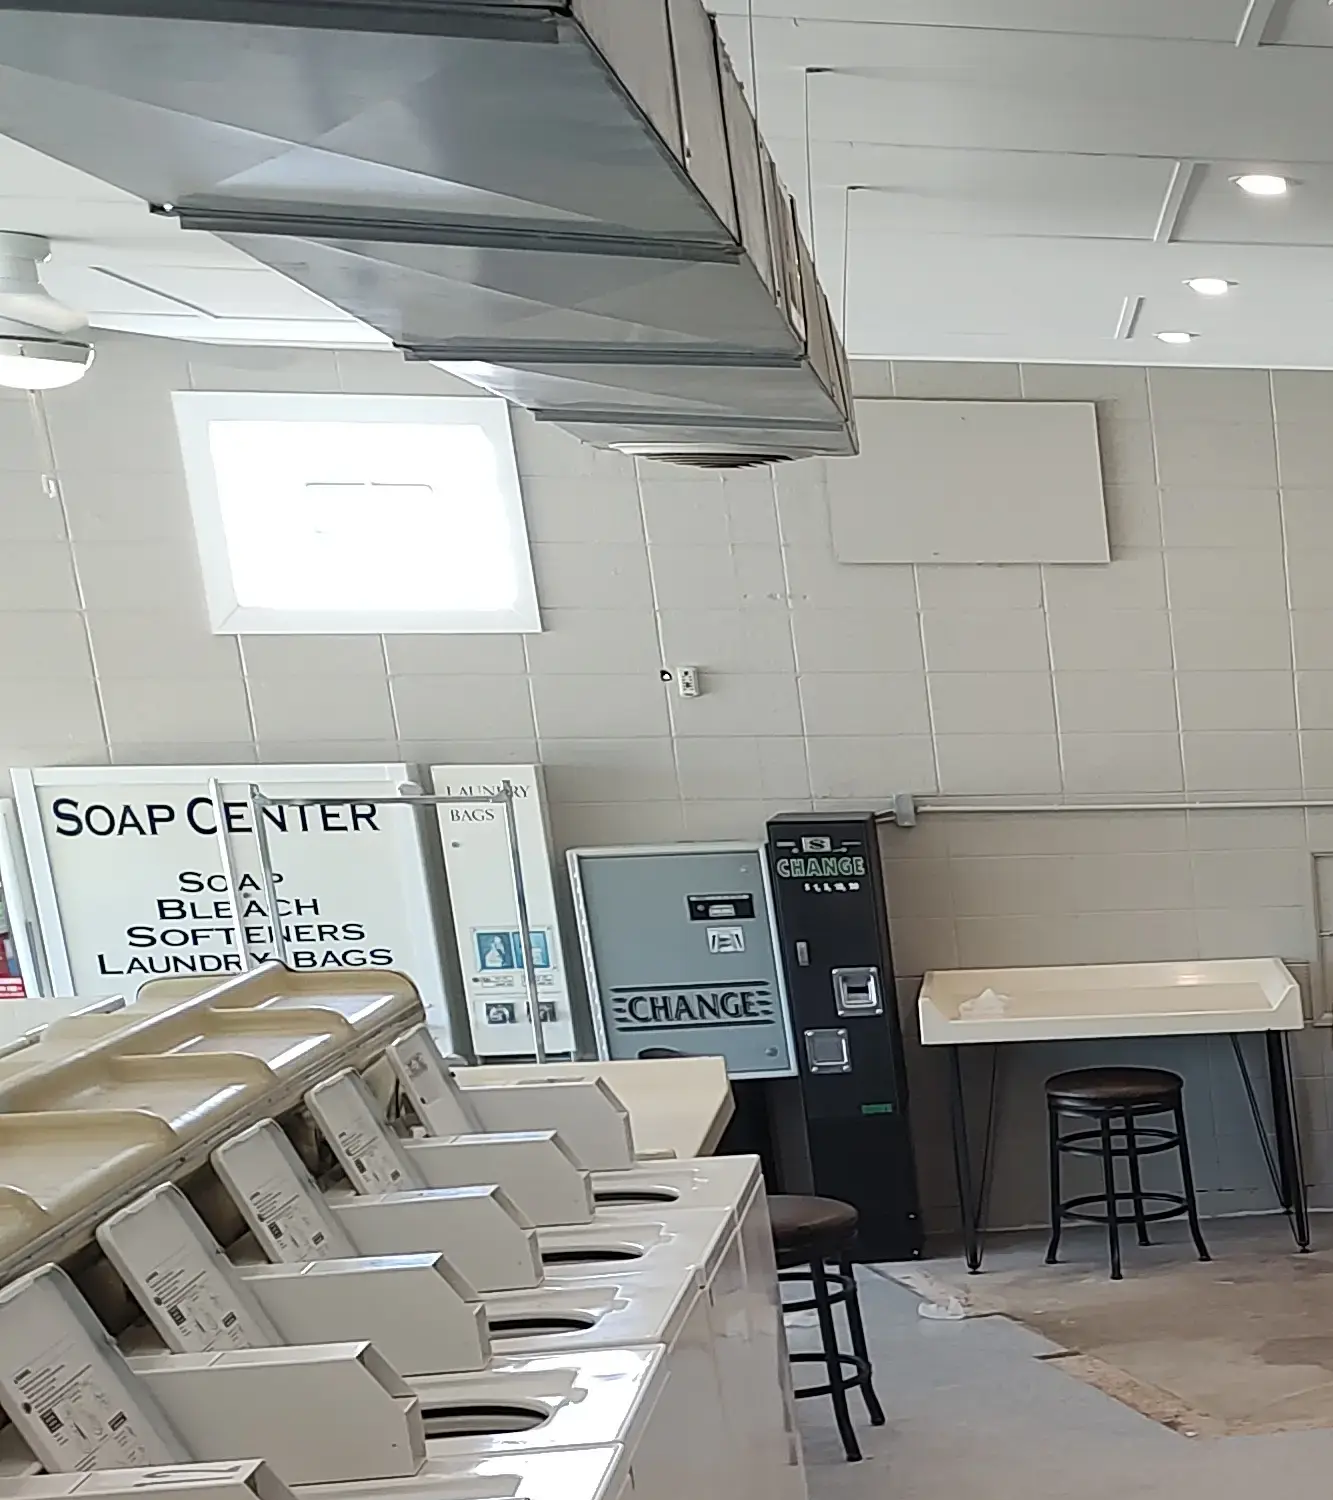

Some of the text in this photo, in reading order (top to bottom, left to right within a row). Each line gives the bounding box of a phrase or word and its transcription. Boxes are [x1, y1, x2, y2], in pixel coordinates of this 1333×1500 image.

[446, 785, 531, 798] LAUNRY
[52, 797, 381, 837] SOAP CENTER
[450, 808, 495, 822] BAGS
[776, 856, 866, 878] CHANGE
[156, 897, 320, 921] BLEACH
[126, 922, 366, 948] SOFTENERS
[97, 948, 394, 976] LAUNDRY BAGS
[627, 990, 760, 1023] CHANGE
